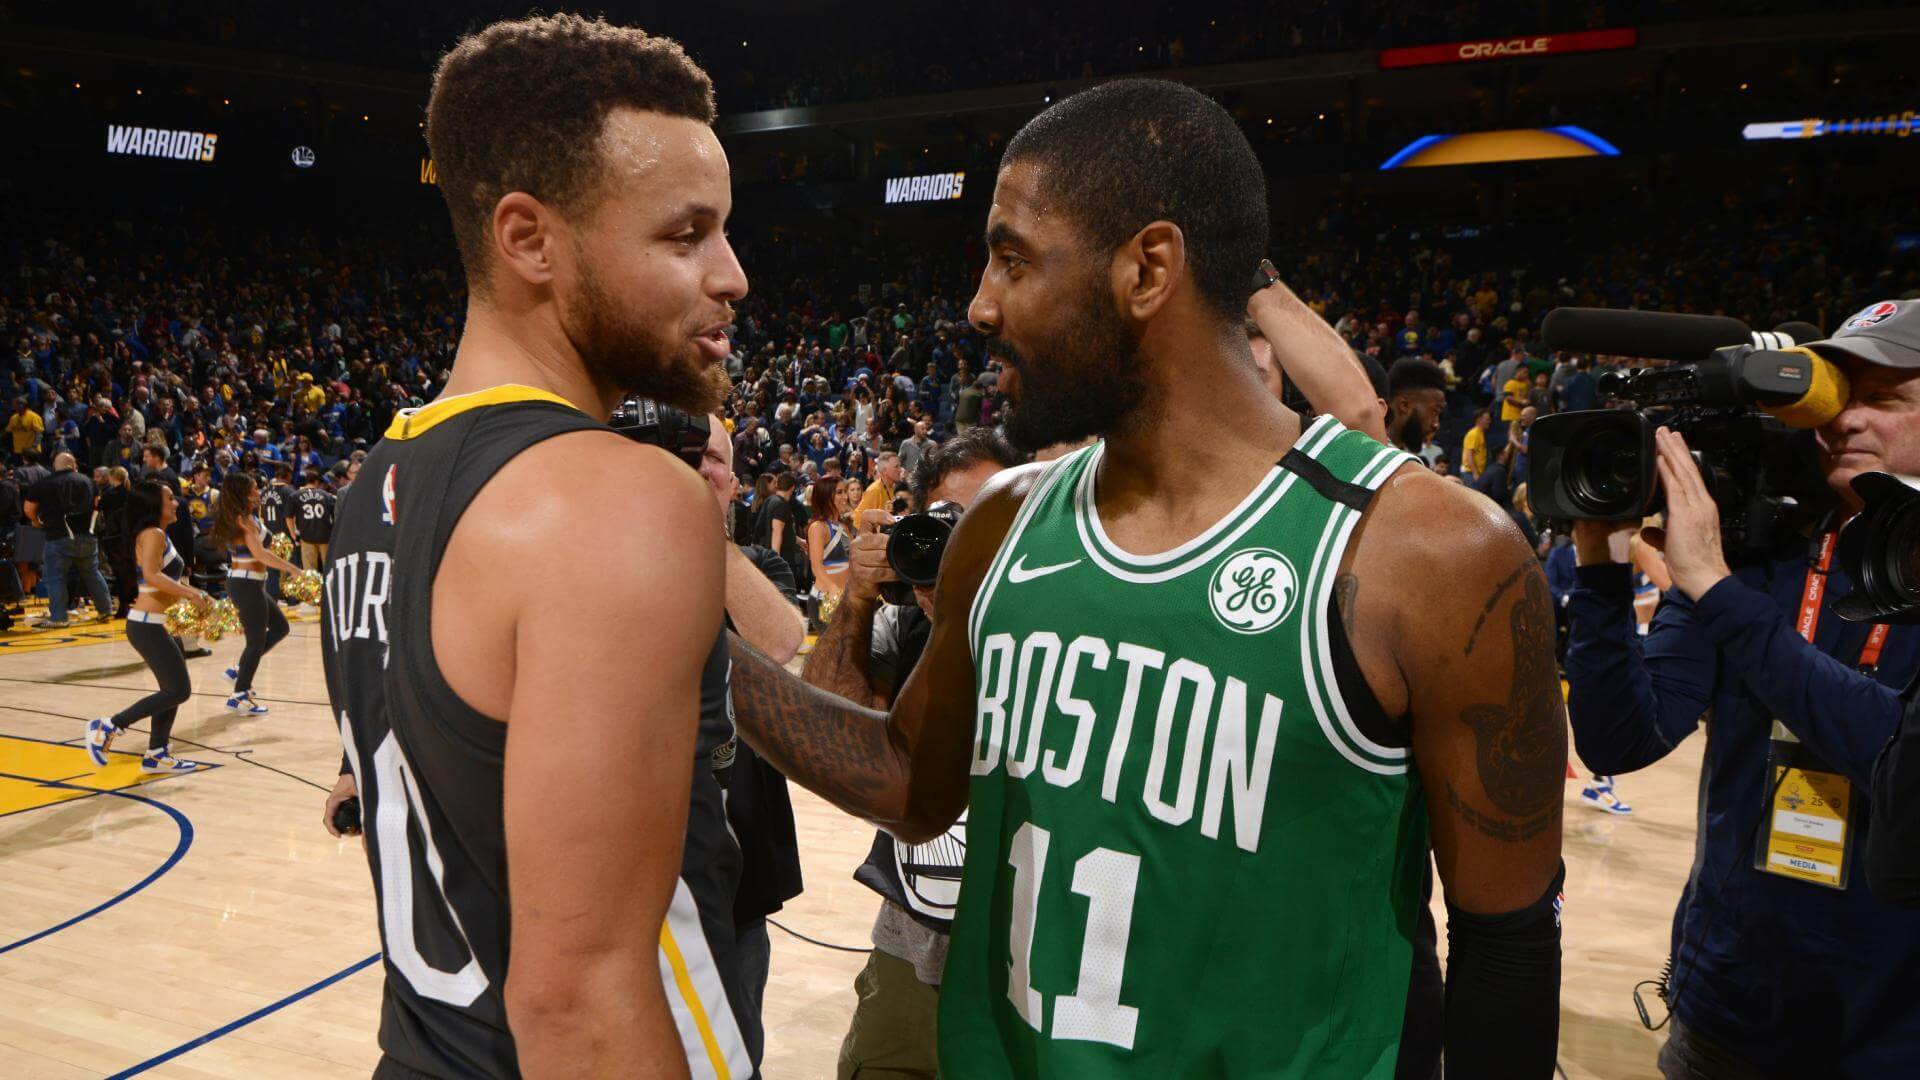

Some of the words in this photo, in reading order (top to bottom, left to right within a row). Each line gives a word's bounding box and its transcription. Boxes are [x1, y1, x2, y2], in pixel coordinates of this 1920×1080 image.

[1459, 38, 1549, 58] ORACLE
[107, 125, 218, 161] WARRIORS
[885, 172, 965, 203] WARRIORS
[267, 505, 276, 521] 11
[302, 503, 324, 520] 30
[1226, 566, 1276, 614] GE
[970, 632, 1283, 854] BOSTON
[1811, 797, 1824, 806] 25
[1789, 858, 1817, 870] MEDIA
[1007, 821, 1141, 1050] 11
